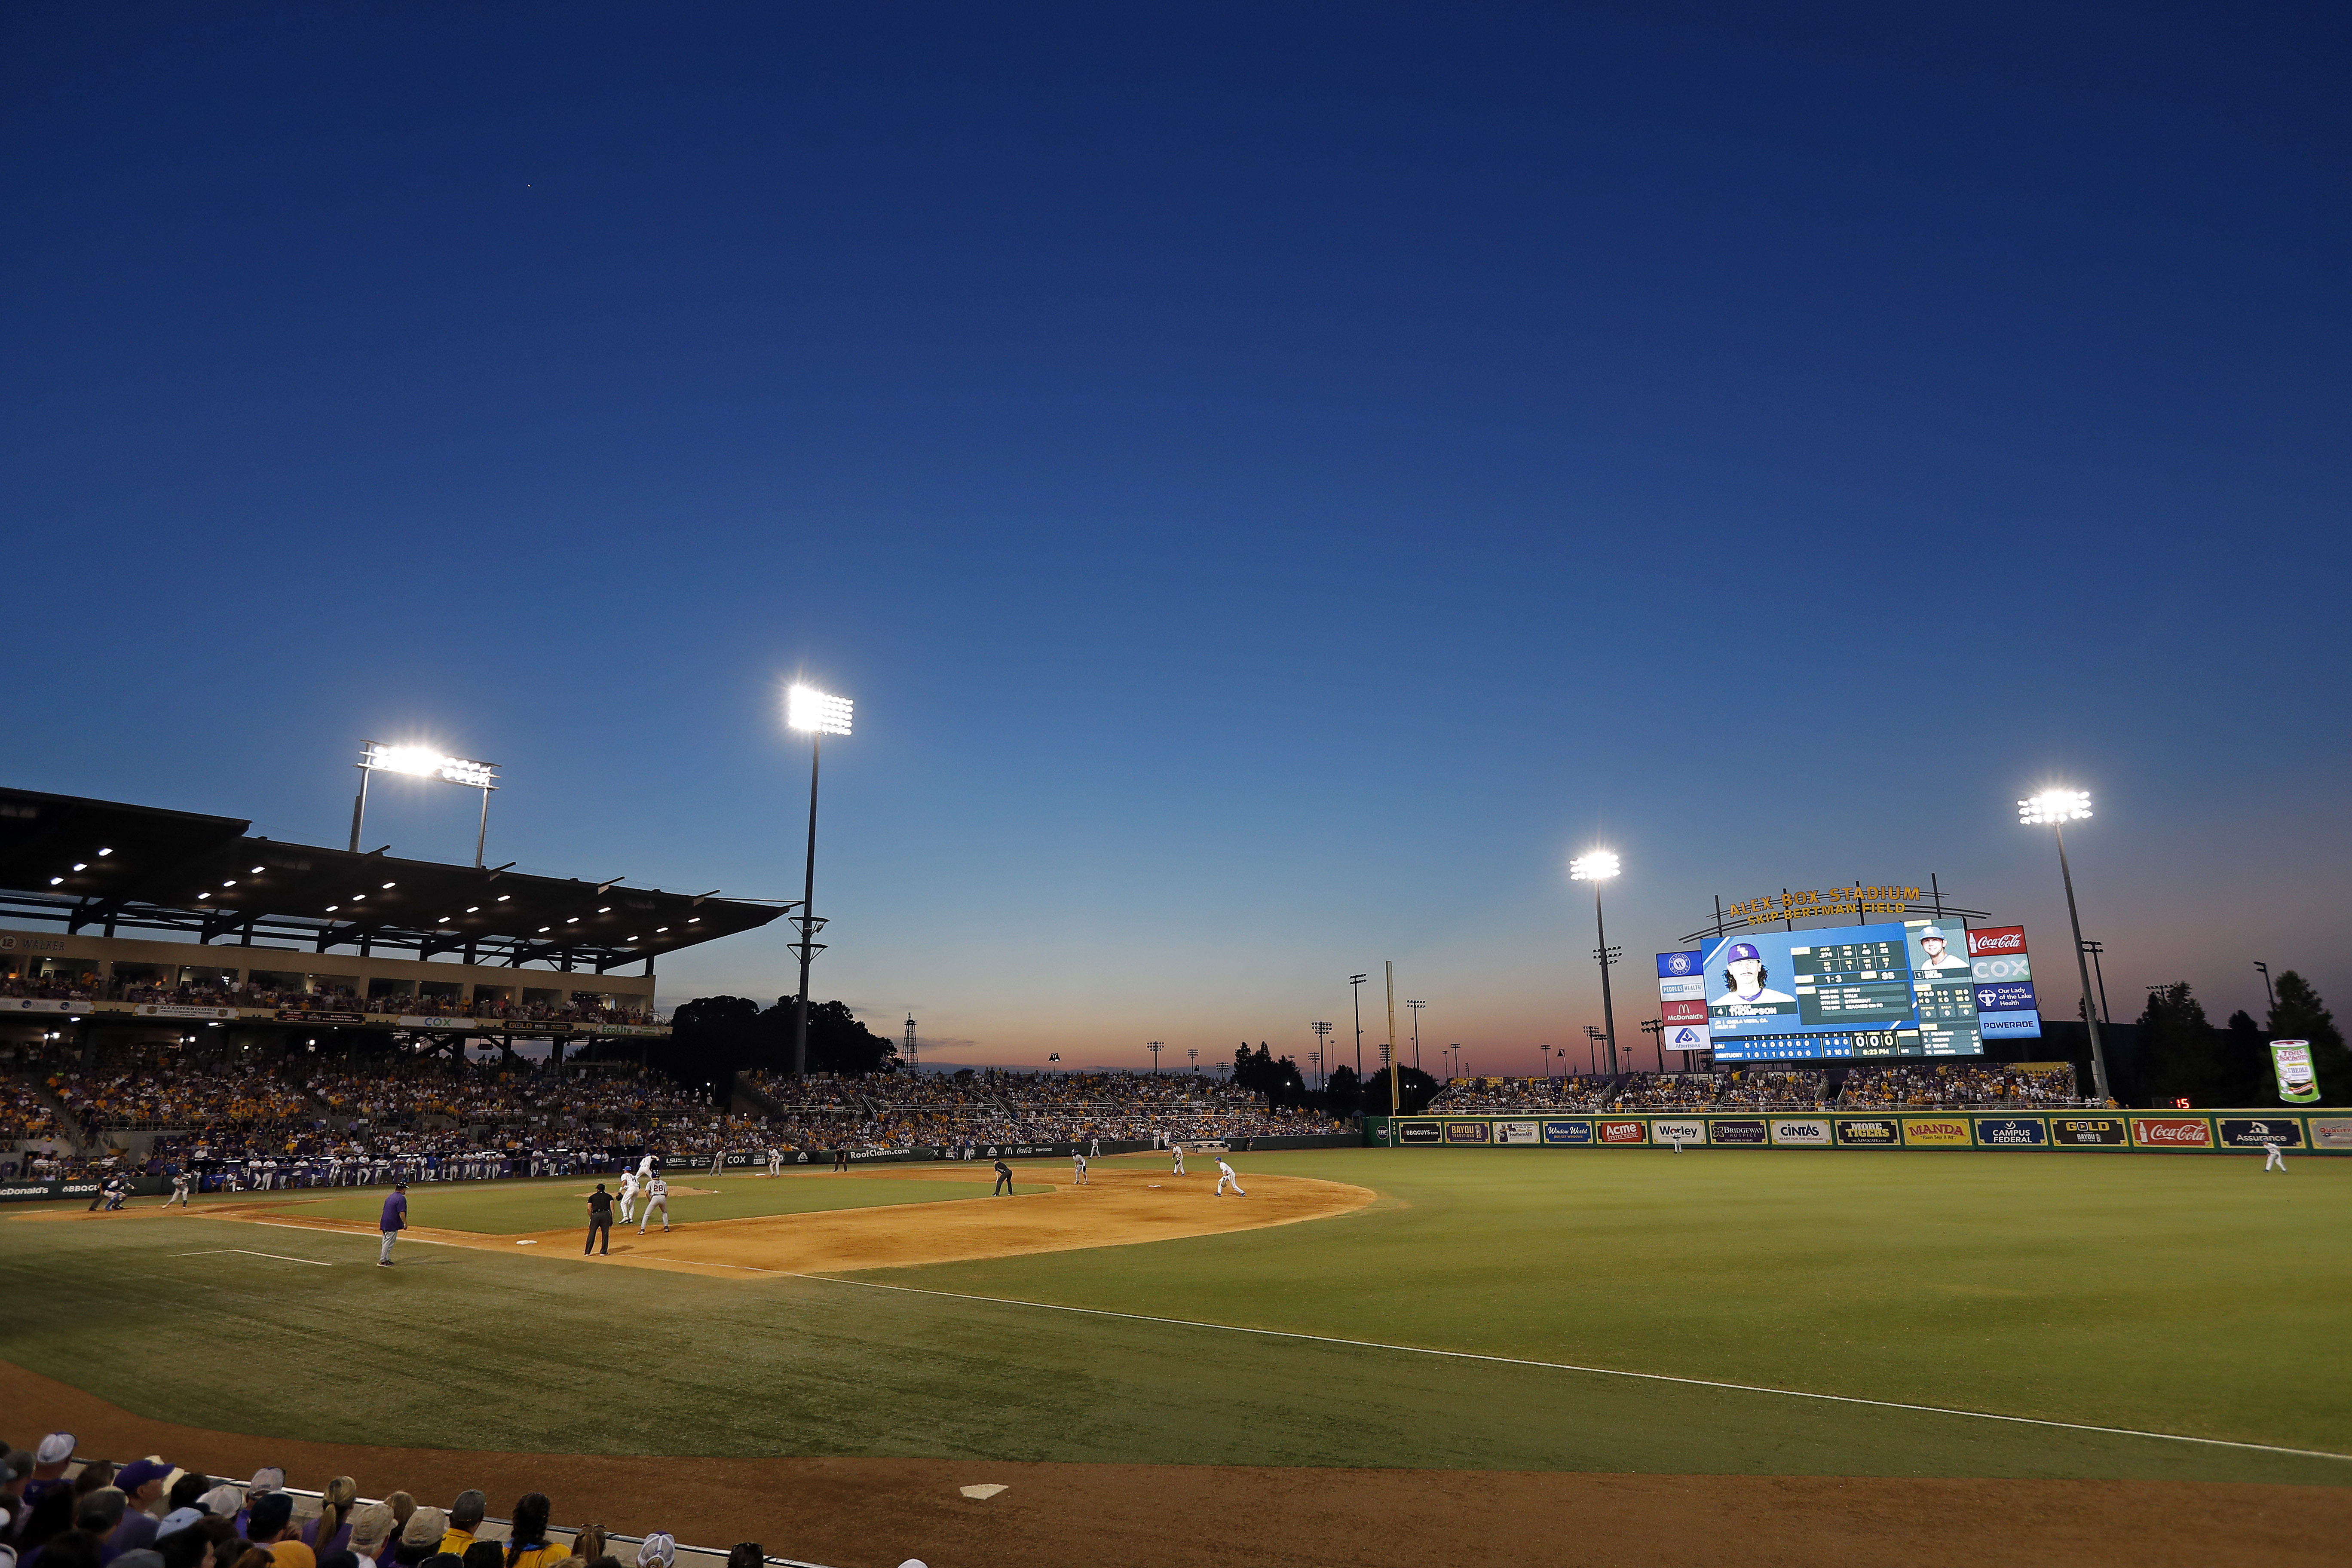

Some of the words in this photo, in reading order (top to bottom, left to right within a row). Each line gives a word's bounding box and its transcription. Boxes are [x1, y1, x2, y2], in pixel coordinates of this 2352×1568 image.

[1730, 896, 1774, 918] ALEX
[1781, 890, 1820, 907] BOX
[1828, 886, 1920, 902] STADIUM
[1747, 911, 1779, 925] SKIP
[1783, 903, 1856, 920] BERTMAN
[1862, 903, 1905, 913] FIELD
[23, 938, 65, 950] WALKER
[1978, 934, 2021, 949] Coca-Cola
[1670, 955, 1689, 963] HANCOCK
[1671, 965, 1689, 974] WHITNEY
[1973, 960, 2028, 978] COX
[1881, 971, 1895, 980] SS
[1729, 1007, 1777, 1017] THOMPSON
[425, 1017, 451, 1027] COX
[1984, 1021, 2034, 1029] POWERADE
[603, 1025, 632, 1034] EcoLite
[1856, 1036, 1865, 1047] 0
[1870, 1035, 1879, 1046] 0
[1884, 1035, 1893, 1046] 0
[2177, 1099, 2189, 1108] 15
[1606, 1124, 1637, 1136] Acme
[1846, 1129, 1890, 1137] TIGERS
[1908, 1124, 1965, 1137] MANDA
[2150, 1124, 2206, 1141] Coca-Cola
[850, 1148, 910, 1159] RoofClaim.com
[727, 1155, 746, 1164] COX
